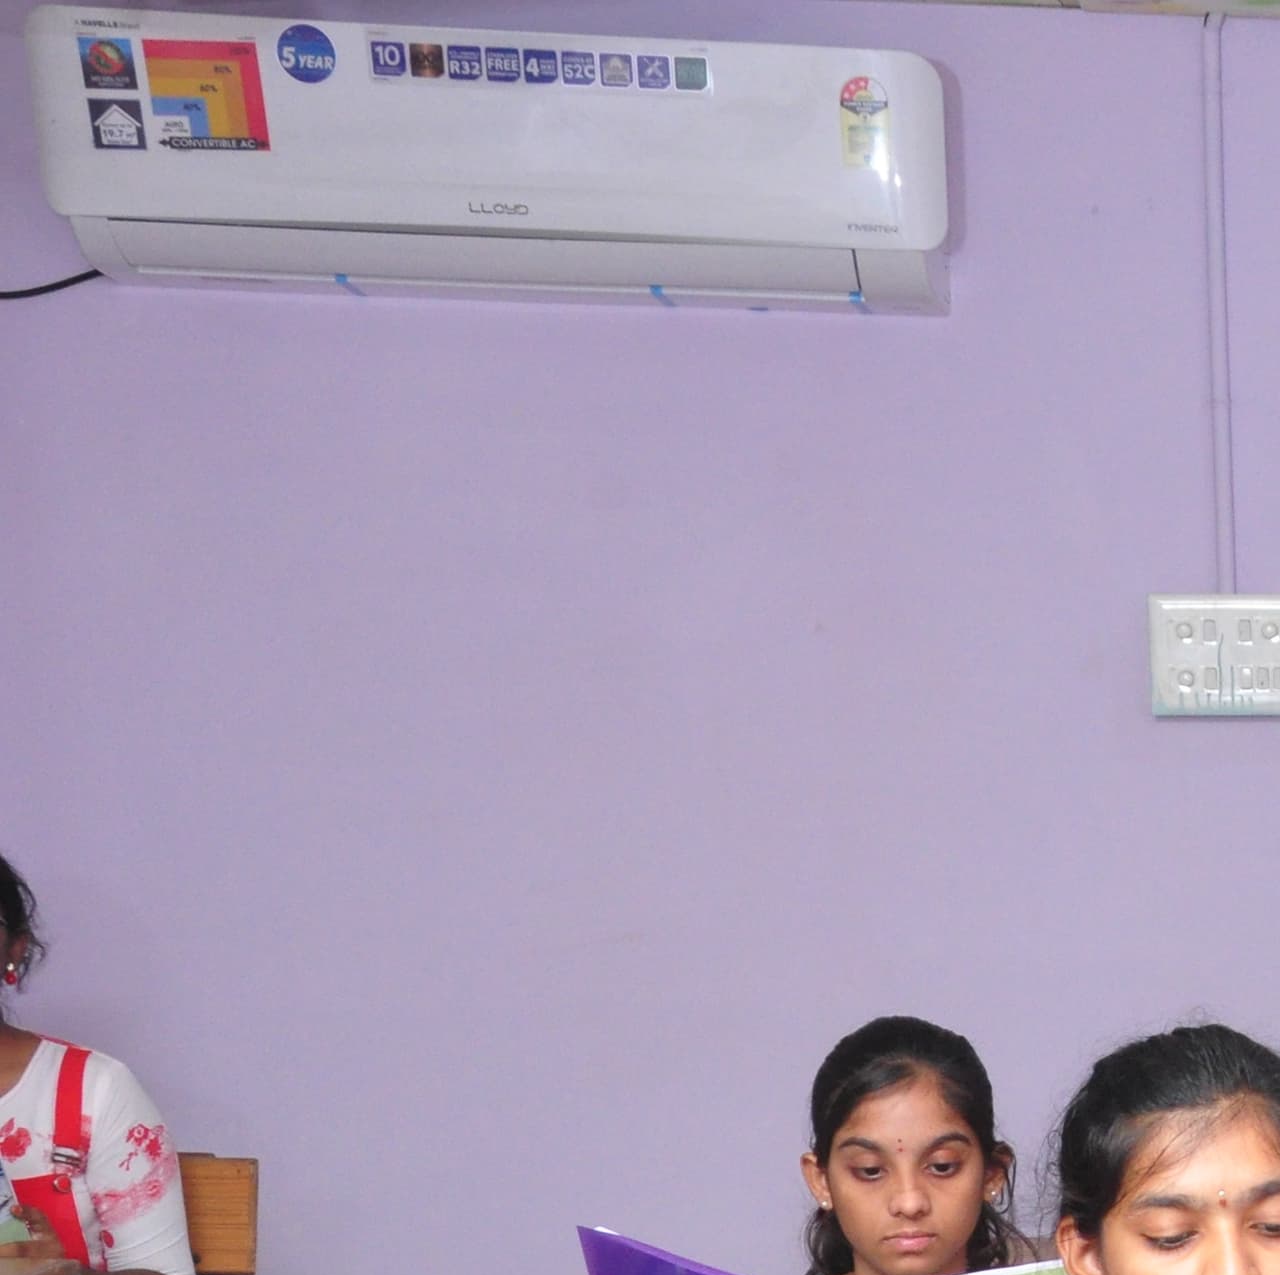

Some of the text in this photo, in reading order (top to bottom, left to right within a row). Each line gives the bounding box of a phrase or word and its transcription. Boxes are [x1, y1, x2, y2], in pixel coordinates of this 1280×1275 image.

[281, 46, 335, 70] 5 YEAR
[374, 45, 401, 66] 10
[449, 60, 481, 76] R32
[487, 58, 520, 72] FREE
[526, 58, 540, 77] 4
[564, 64, 595, 80] 52C
[171, 138, 257, 149] CONVERTIBLE AC
